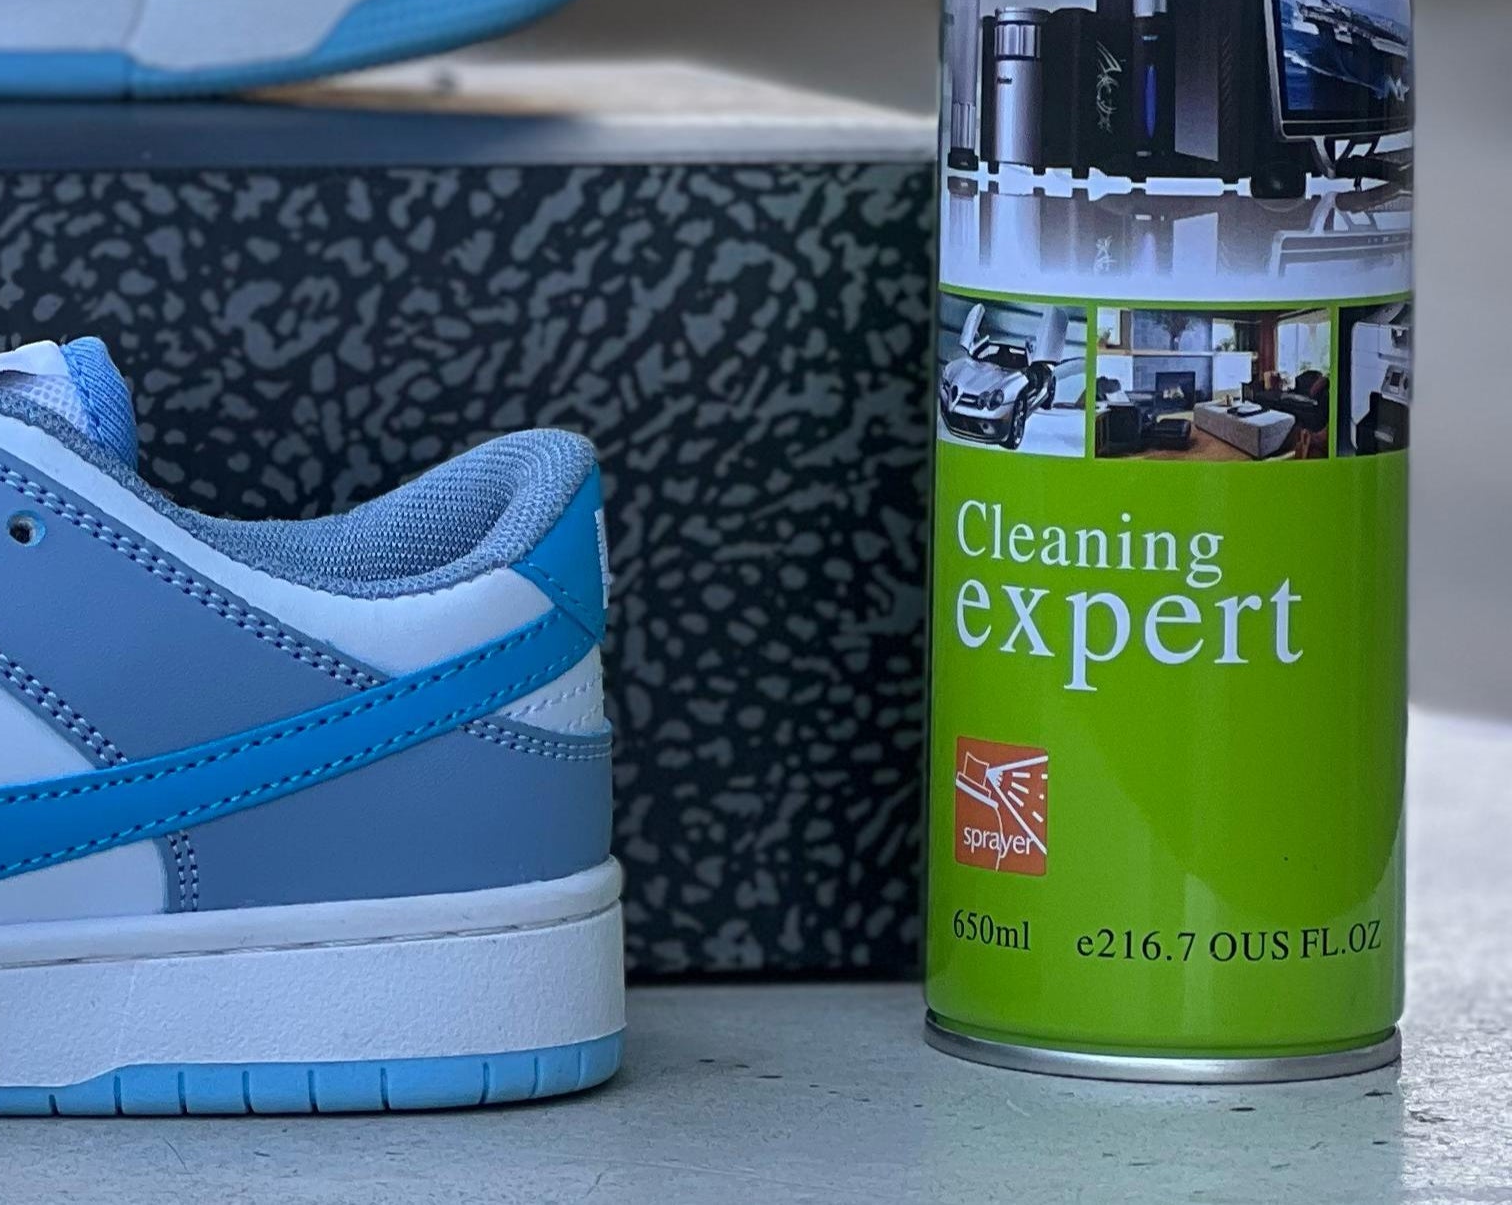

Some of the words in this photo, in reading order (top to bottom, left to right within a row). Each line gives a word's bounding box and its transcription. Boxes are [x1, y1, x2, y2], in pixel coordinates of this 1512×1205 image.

[957, 499, 1224, 589] Cleaning
[956, 577, 1304, 691] expert
[963, 824, 1033, 859] sprayer
[953, 909, 1031, 951] 650ml
[1076, 929, 1196, 962] e216.7
[1208, 930, 1289, 963] OUS
[1299, 920, 1382, 958] FL.OZ
